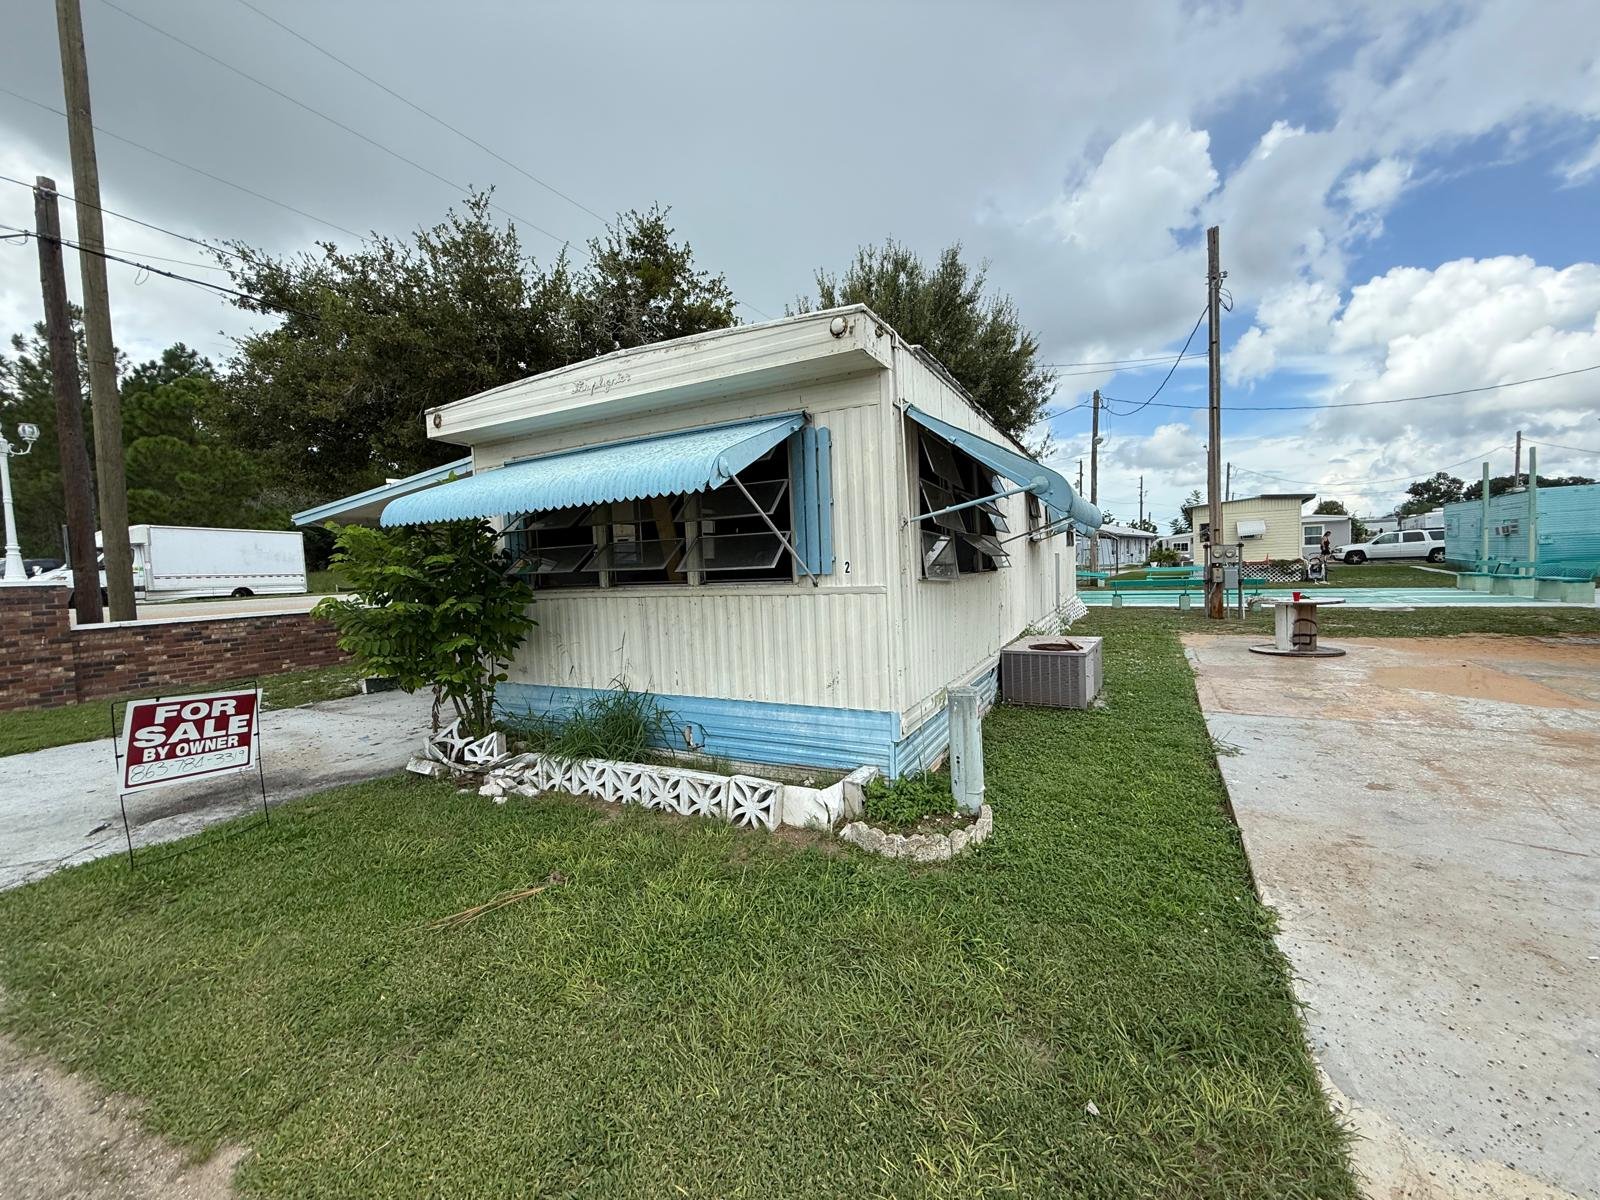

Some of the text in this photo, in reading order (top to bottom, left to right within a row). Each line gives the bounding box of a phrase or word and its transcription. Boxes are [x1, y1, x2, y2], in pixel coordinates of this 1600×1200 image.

[844, 561, 851, 574] 2
[154, 699, 237, 724] FOR
[133, 714, 250, 748] SALE
[142, 735, 239, 763] BY OWNER
